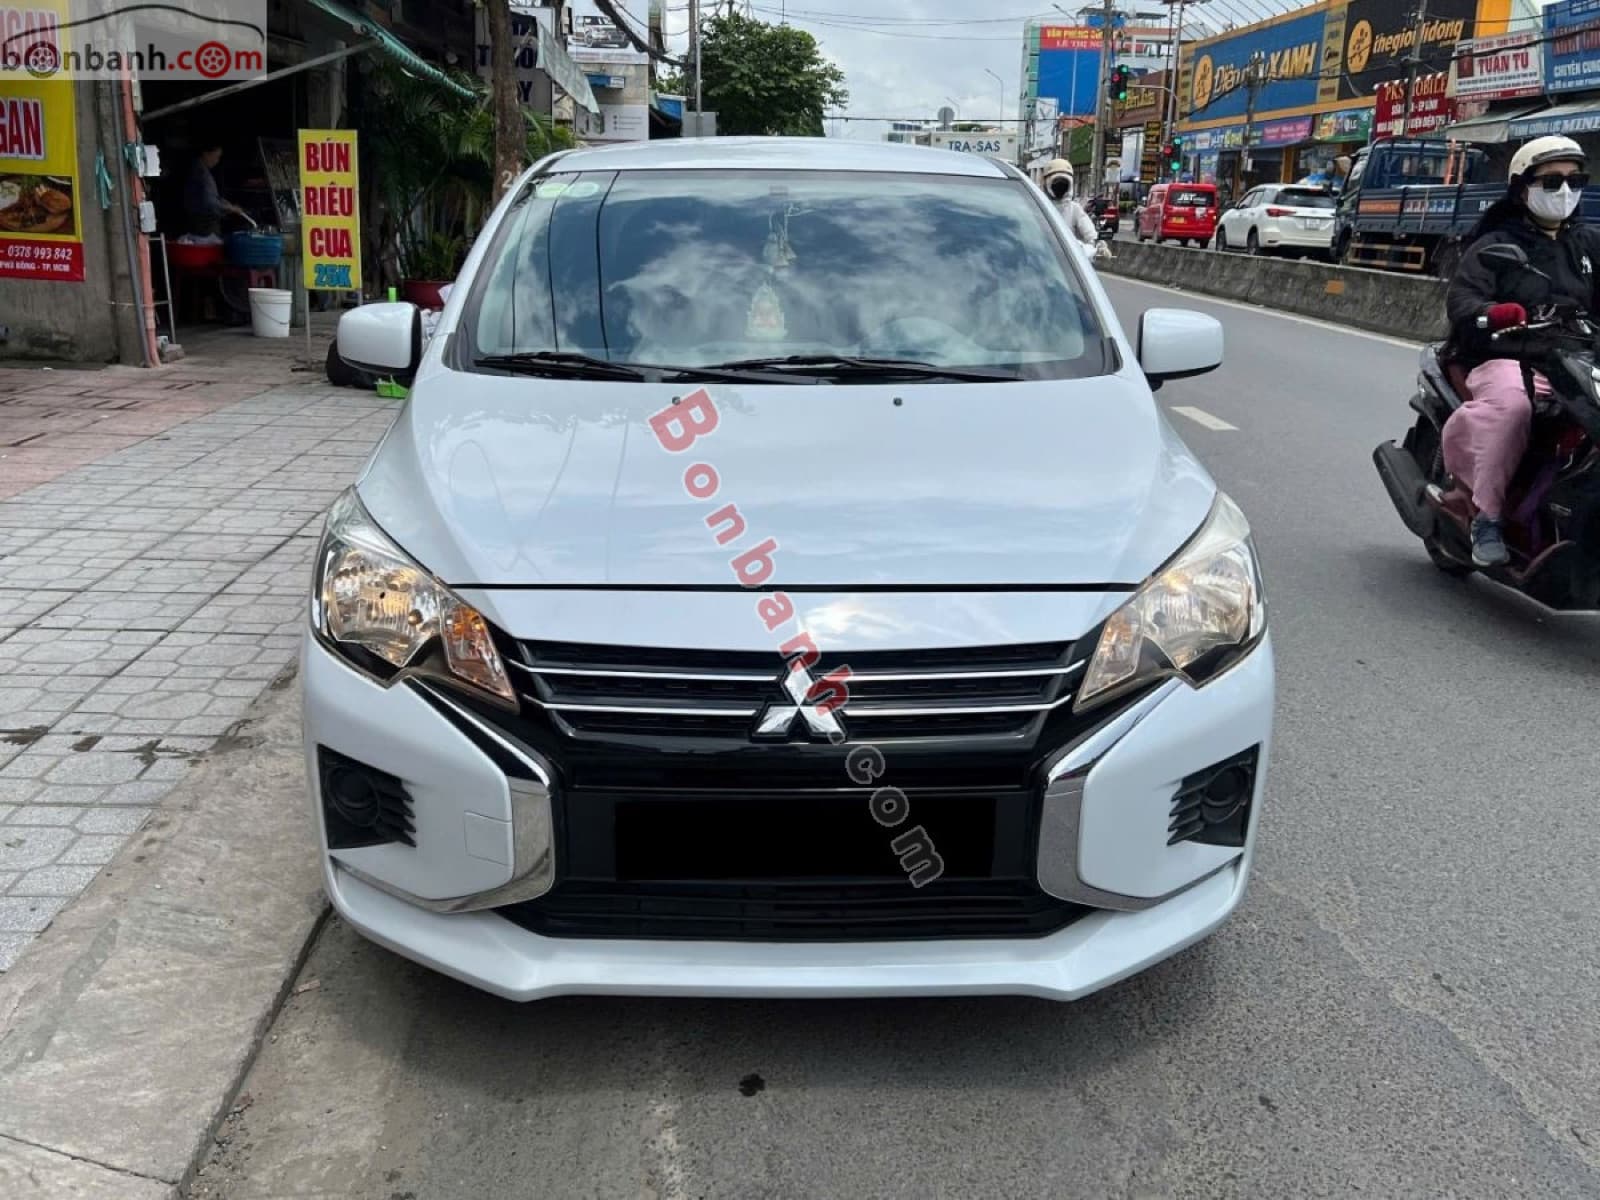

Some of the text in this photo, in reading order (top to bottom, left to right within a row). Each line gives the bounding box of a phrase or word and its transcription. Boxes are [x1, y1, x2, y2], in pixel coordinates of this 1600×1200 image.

[1268, 41, 1318, 80] XANH
[305, 137, 349, 172] BÚN
[948, 140, 1000, 152] TRA-SAS
[305, 182, 353, 216] RIÊU
[8, 244, 72, 260] 0378 993 842
[310, 227, 352, 258] CUA
[314, 264, 352, 287] 25K
